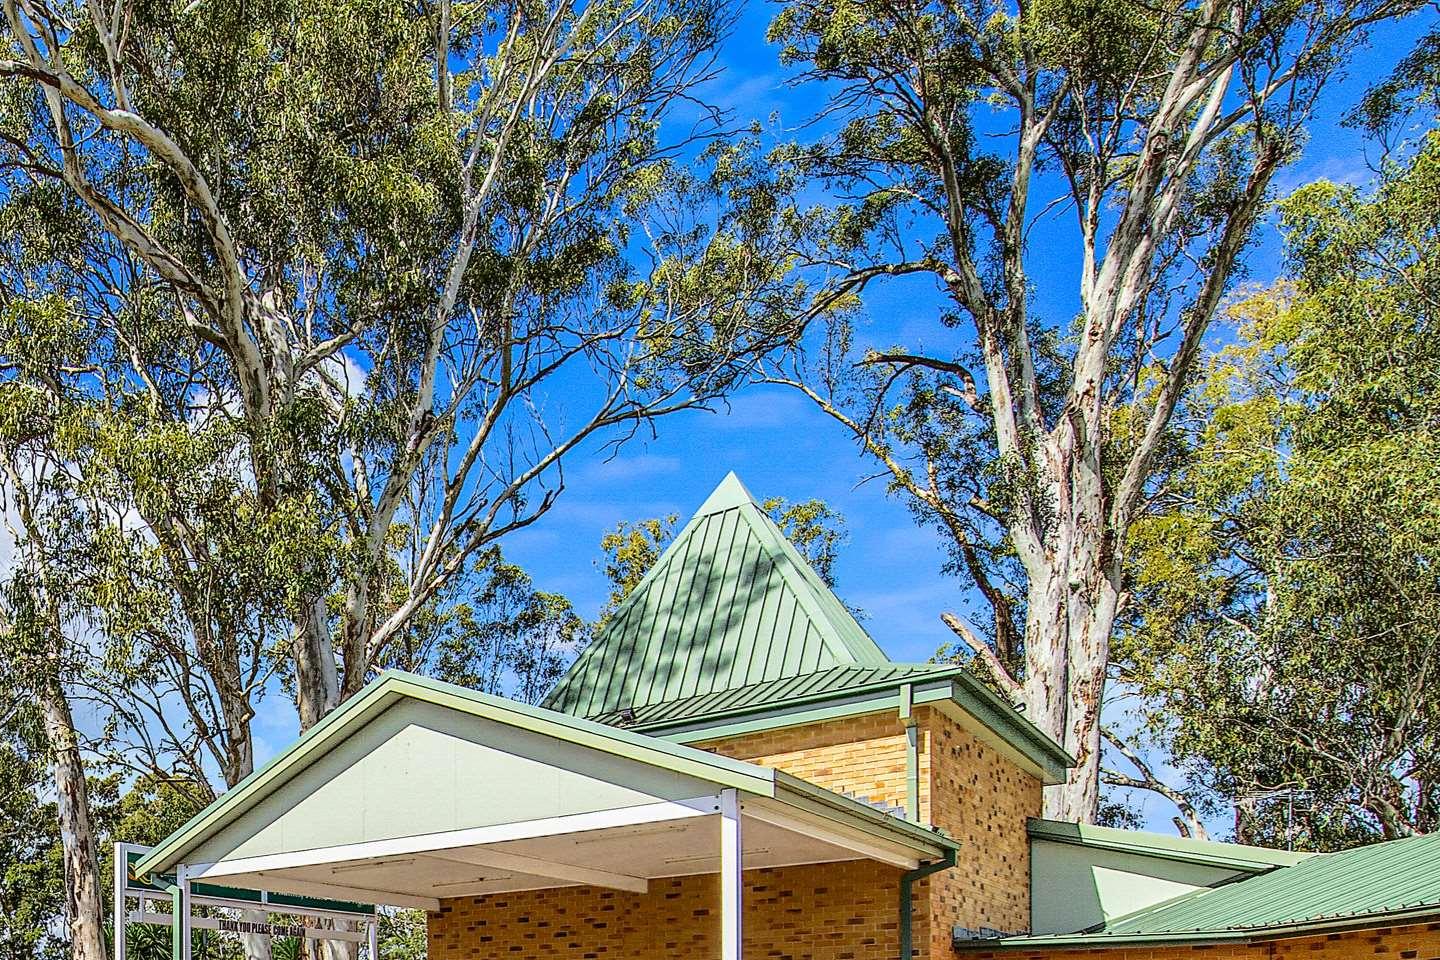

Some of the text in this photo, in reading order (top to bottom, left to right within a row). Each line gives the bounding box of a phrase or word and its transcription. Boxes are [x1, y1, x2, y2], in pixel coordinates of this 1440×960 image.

[219, 920, 306, 937] THANK YOU PLEASE COME AGAIN
